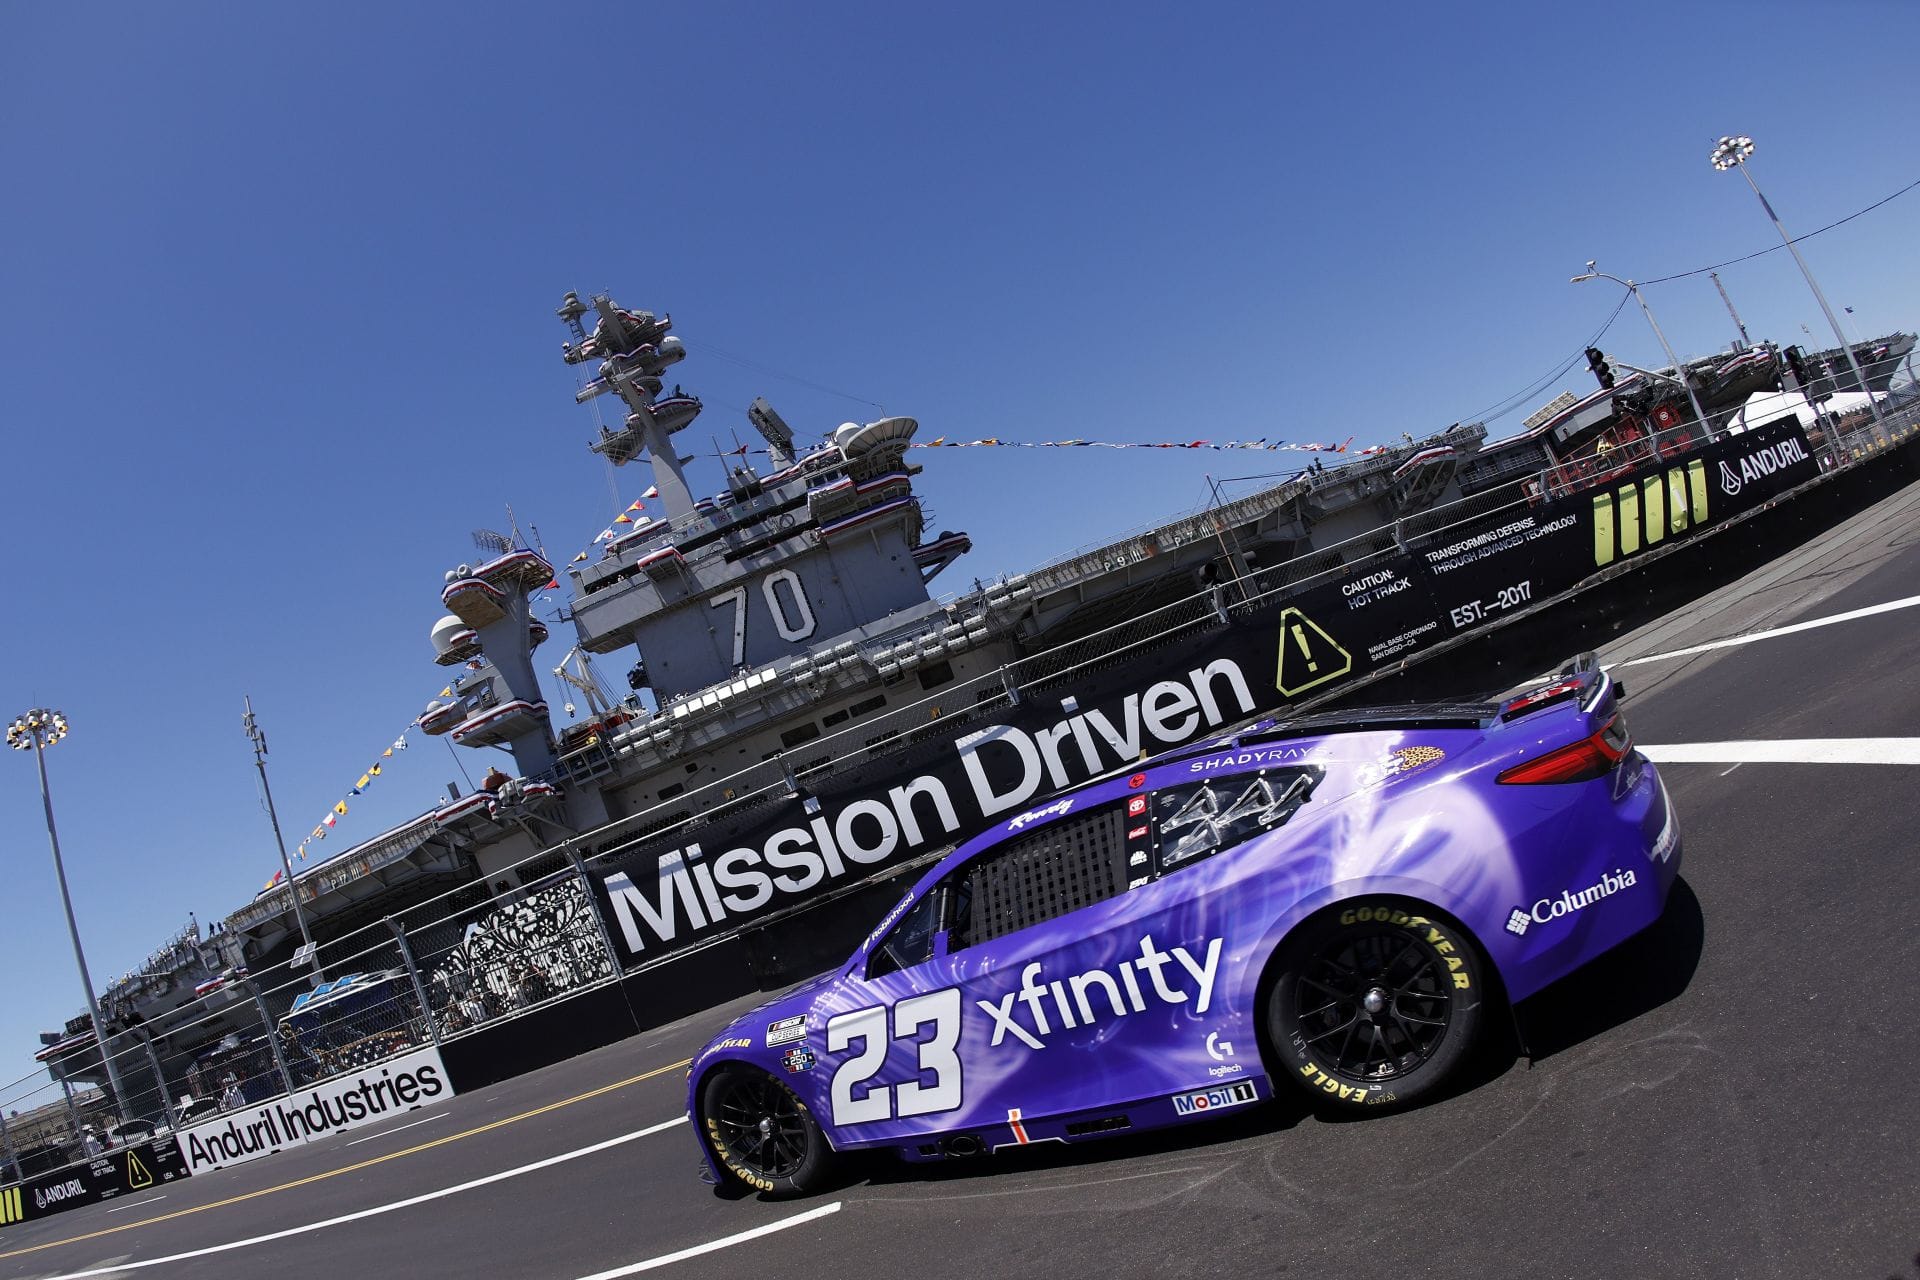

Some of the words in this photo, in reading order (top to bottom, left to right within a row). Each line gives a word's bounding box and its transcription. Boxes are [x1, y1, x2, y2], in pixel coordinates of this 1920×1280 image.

[1740, 437, 1808, 484] ANDURIL
[1425, 531, 1498, 563] TRANSFORMING
[1497, 517, 1536, 540] DEFENSE
[1431, 554, 1478, 575] THROUGH
[1478, 536, 1524, 560] ADVANCED
[1524, 514, 1577, 543] TECHNOLOGY
[1342, 569, 1395, 597] CAUTION:
[1347, 594, 1372, 610] HOT
[1374, 577, 1412, 598] TRACK
[709, 569, 818, 666] 70
[1368, 641, 1388, 654] NAVAL
[1387, 635, 1403, 648] BASE
[1402, 621, 1437, 642] CORONADO
[1371, 650, 1385, 662] SAN
[603, 774, 960, 954] Mission
[953, 658, 1256, 818] Driven
[1007, 799, 1075, 831] Rowdy
[871, 892, 915, 941] Robinhood
[1531, 868, 1637, 924] Columbia
[1340, 907, 1470, 989] GOODYEAR
[976, 934, 1224, 1050] xfinity
[790, 1053, 808, 1066] 250
[826, 987, 962, 1127] 23
[1208, 1063, 1242, 1077] logitech
[1175, 1088, 1232, 1113] Mobil
[1300, 1062, 1368, 1102] EAGLE
[190, 1108, 281, 1169] Anduril
[276, 1065, 443, 1141] Industries
[163, 1171, 174, 1180] USA
[707, 1117, 775, 1191] GOODYEAR
[45, 1178, 87, 1204] ANDURIL
